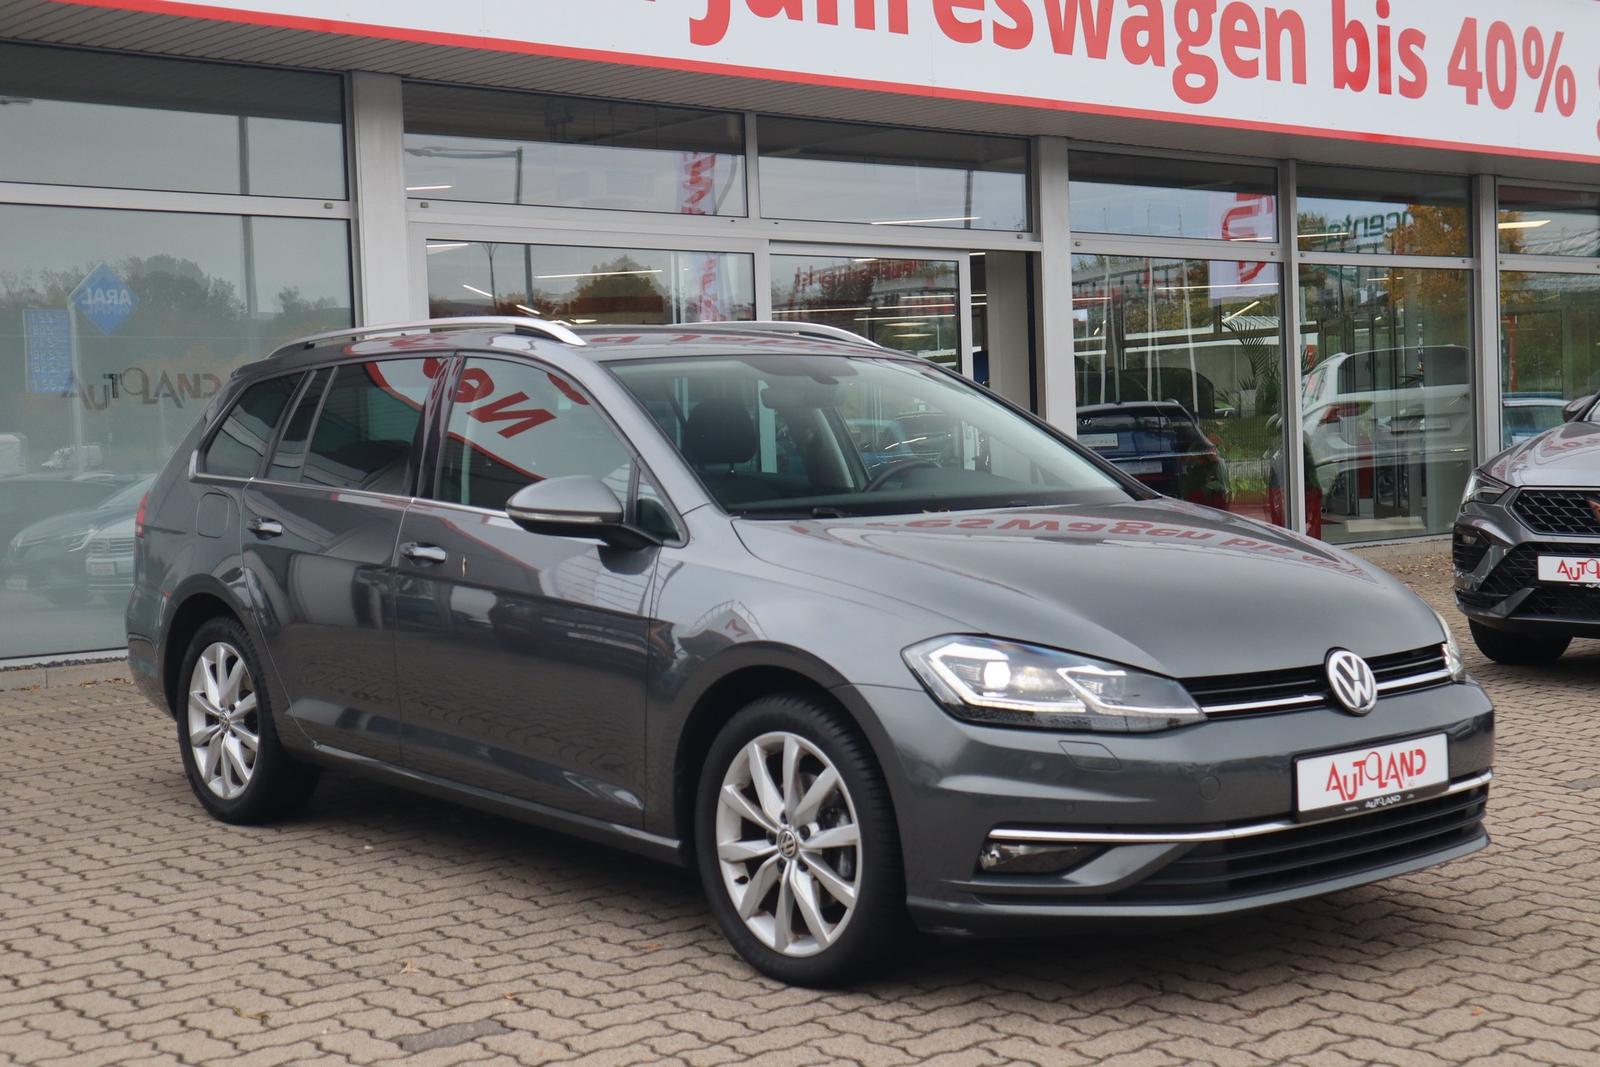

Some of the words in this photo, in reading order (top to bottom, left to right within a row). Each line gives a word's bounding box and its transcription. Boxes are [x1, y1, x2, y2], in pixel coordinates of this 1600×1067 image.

[689, 0, 1307, 104] eswagen
[1331, 0, 1427, 99] bis
[1447, 16, 1577, 117] 40%
[1325, 748, 1427, 801] AUTOLAND
